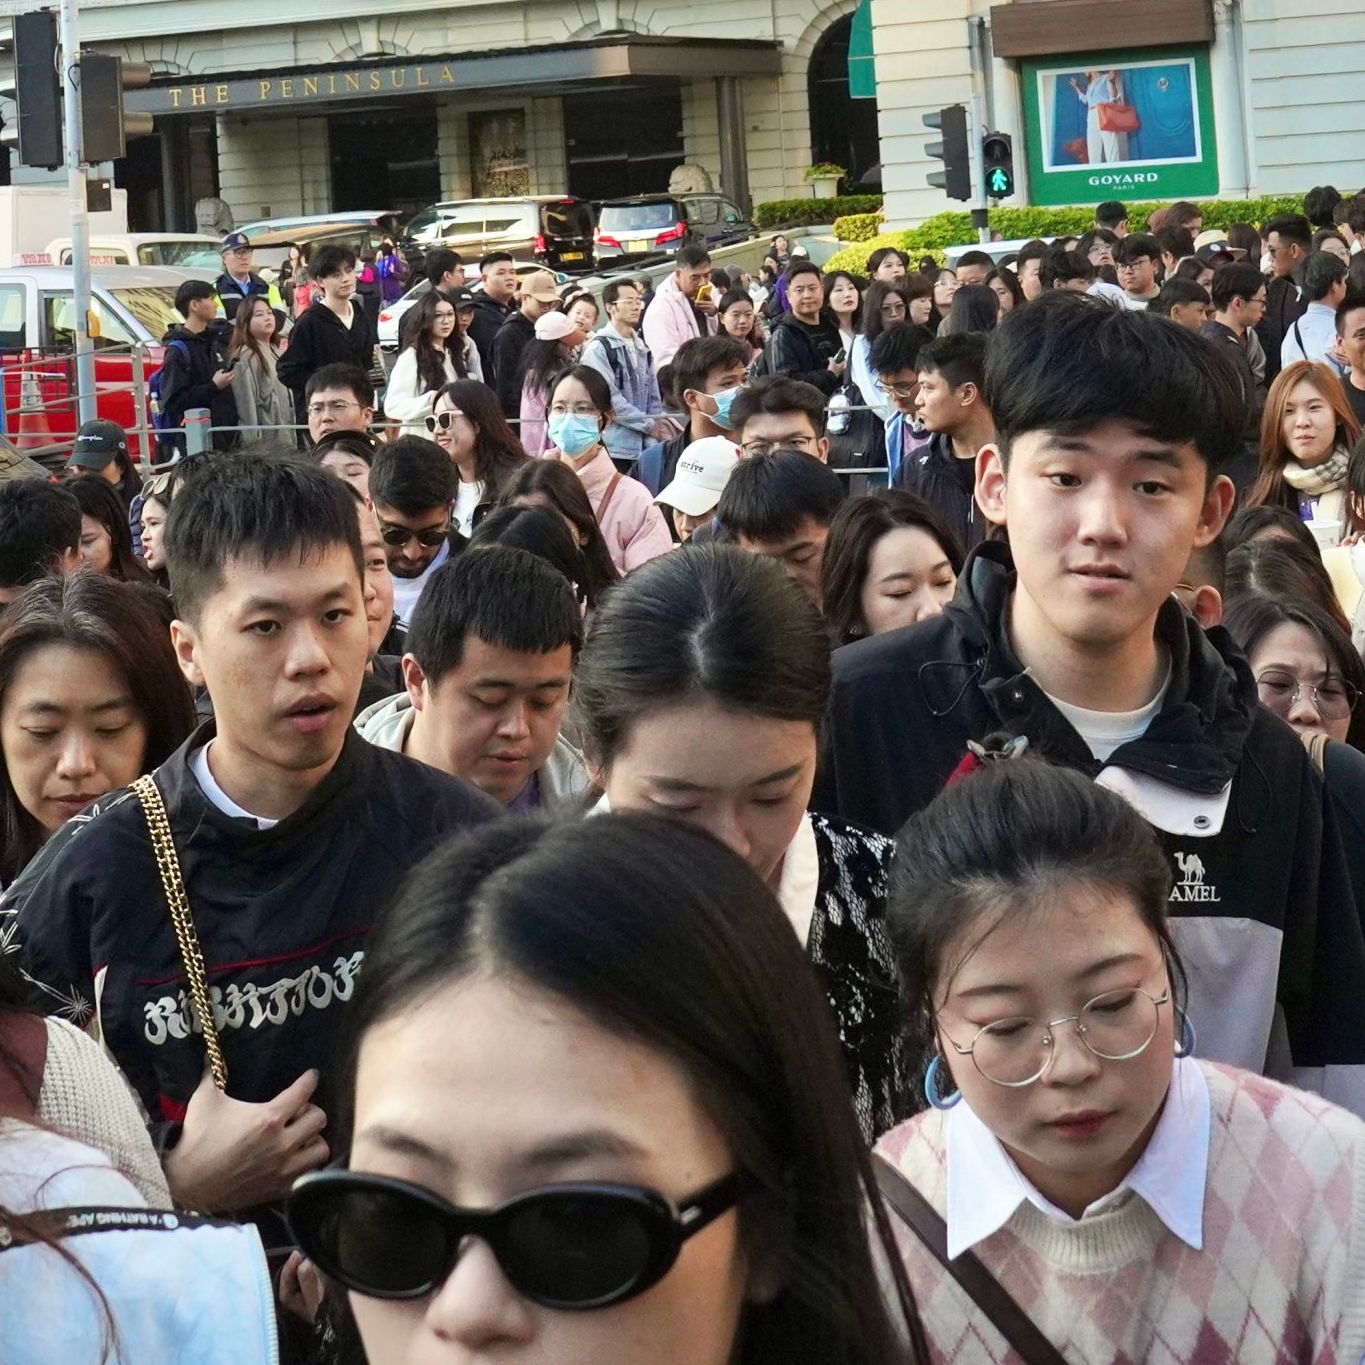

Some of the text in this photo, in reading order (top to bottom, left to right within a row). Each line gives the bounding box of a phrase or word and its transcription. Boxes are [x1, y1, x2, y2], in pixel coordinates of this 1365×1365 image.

[168, 64, 456, 107] THE PENINSULA
[1088, 172, 1159, 186] GOYARD
[21, 253, 52, 264] TAXI
[90, 255, 114, 265] TAXI
[1168, 886, 1221, 902] AMEL
